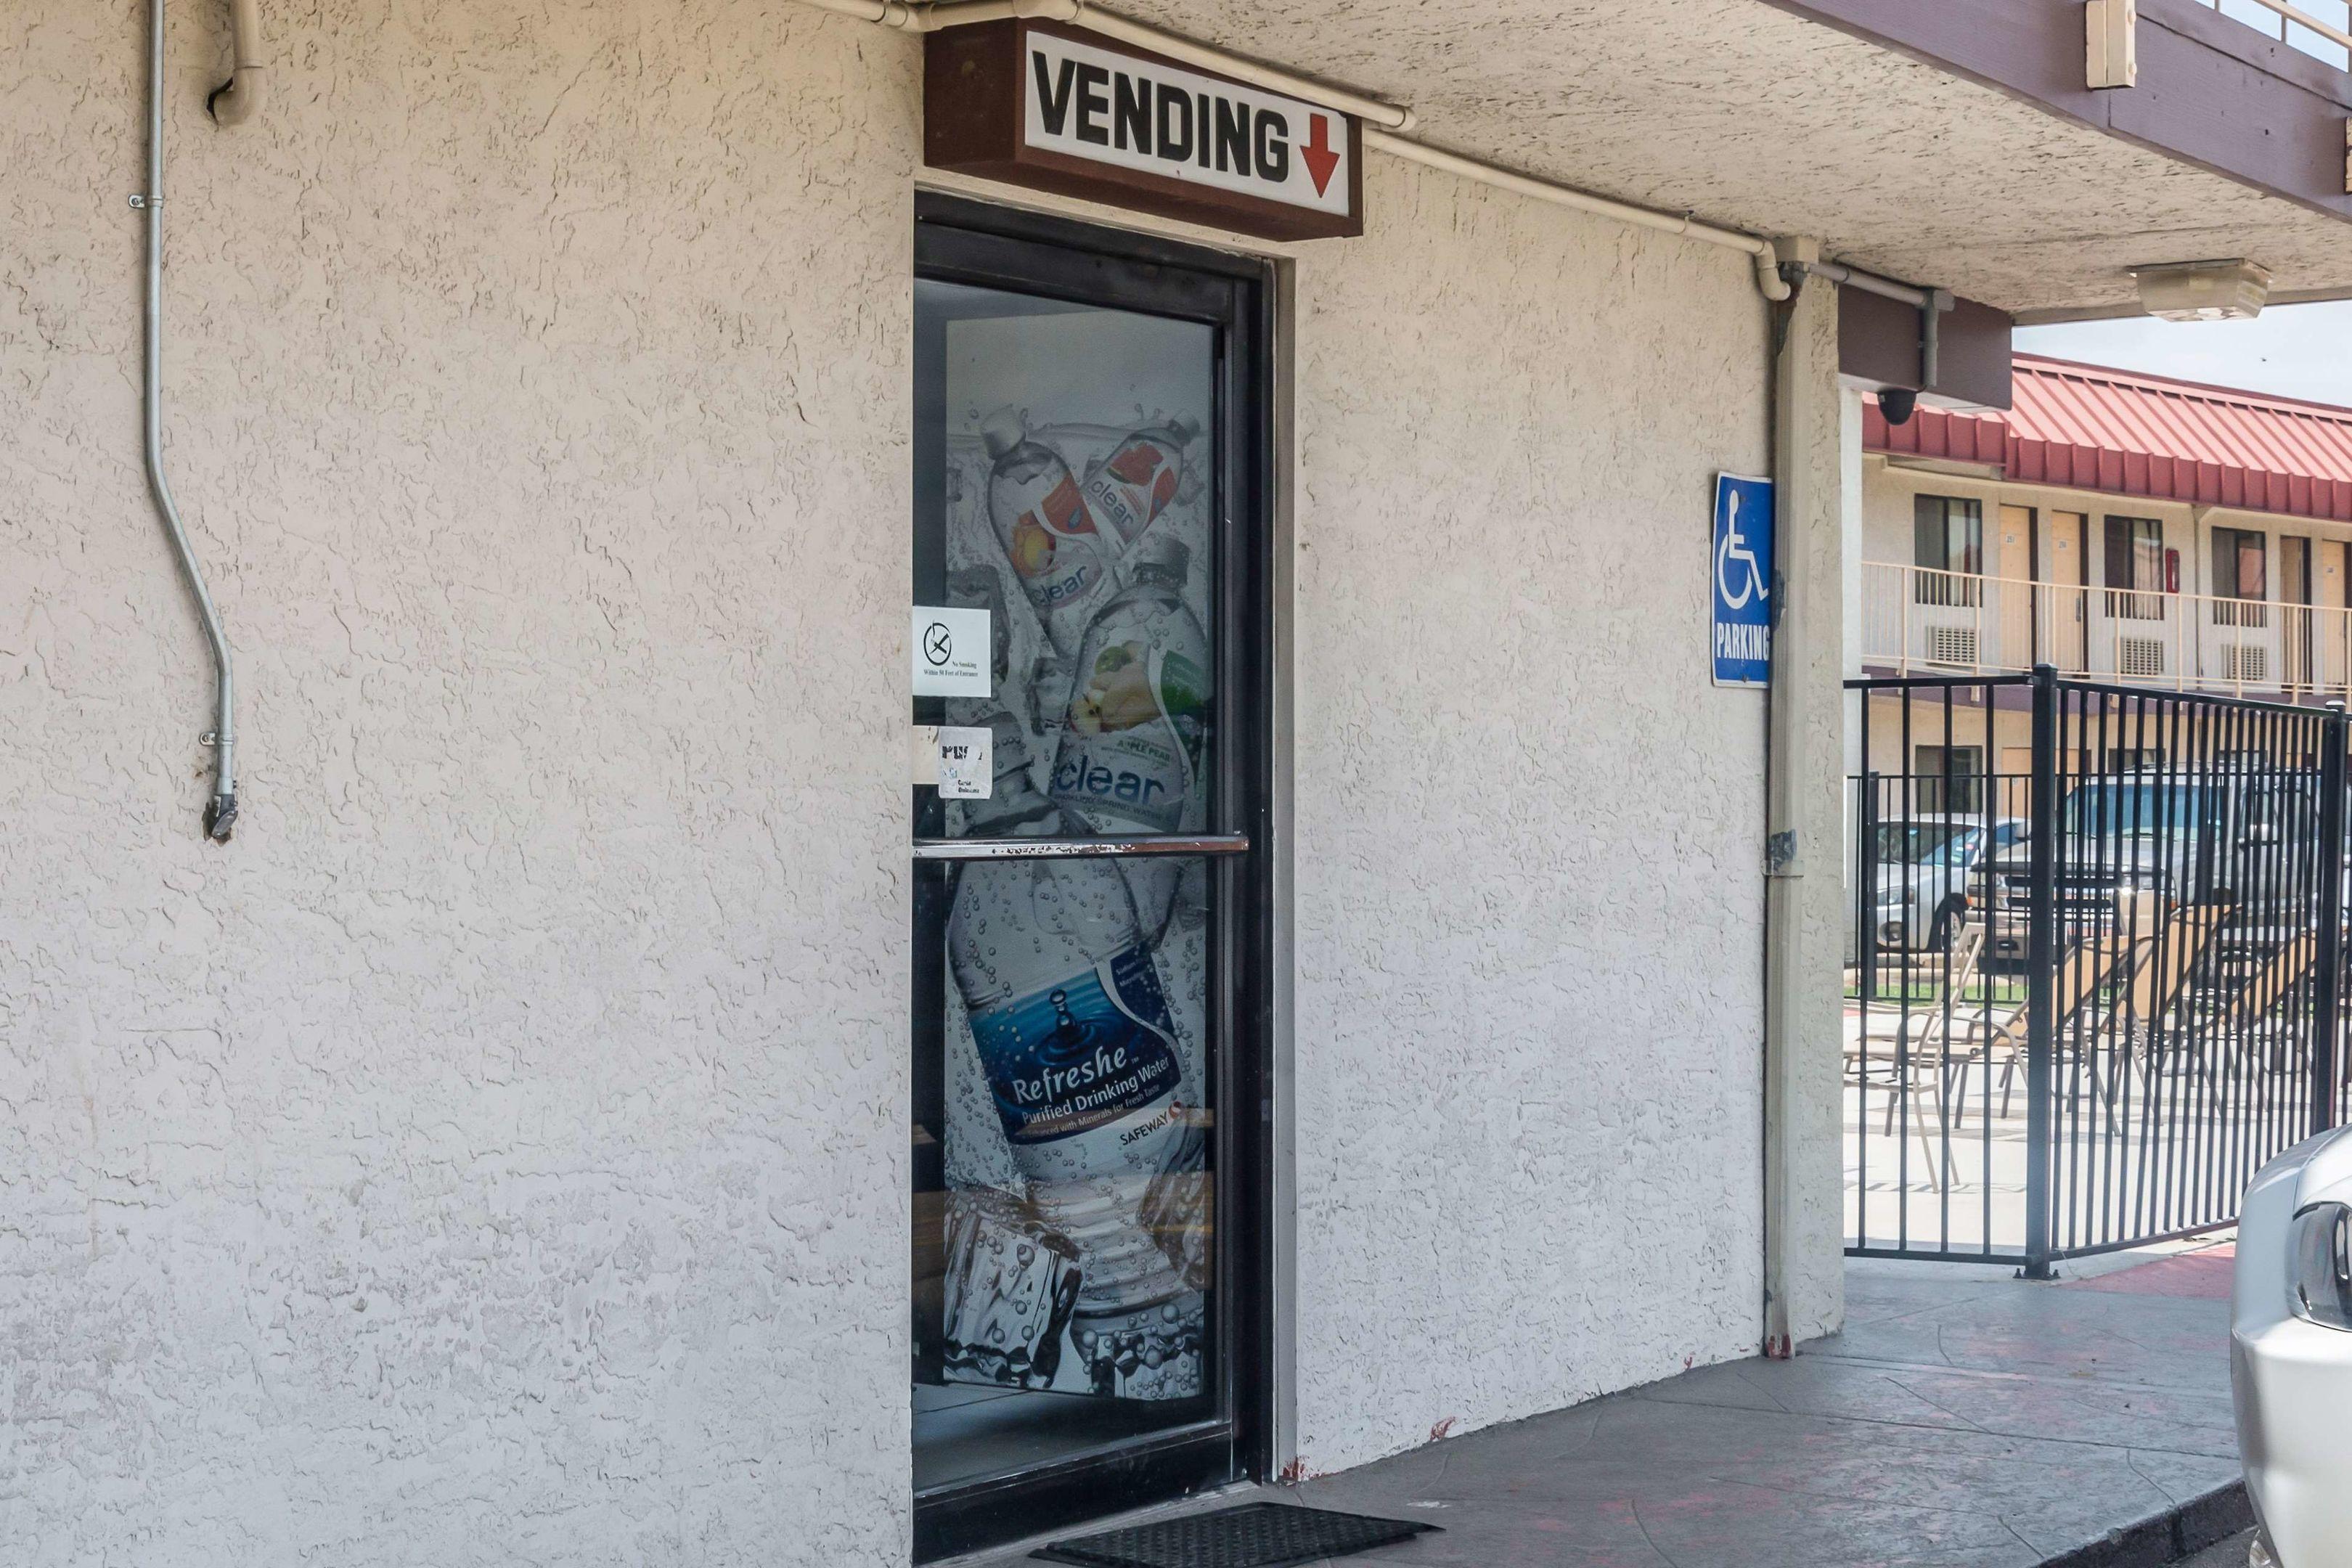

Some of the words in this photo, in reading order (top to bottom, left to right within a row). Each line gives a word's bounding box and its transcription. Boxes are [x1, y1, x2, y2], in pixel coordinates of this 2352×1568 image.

[1032, 50, 1289, 183] VENDING
[1091, 481, 1134, 524] clear
[1717, 622, 1770, 661] PARKING
[1055, 755, 1164, 804] clear
[1012, 1045, 1127, 1104] Refreshe
[1021, 1098, 1074, 1124] Purified
[1075, 1075, 1139, 1111] Drinking
[1138, 1056, 1169, 1084] Water
[1060, 1120, 1078, 1132] with
[1078, 1108, 1112, 1126] Minerals
[1113, 1103, 1124, 1114] for
[1125, 1093, 1145, 1108] Fresh
[1119, 1111, 1169, 1146] SAFEWAY
